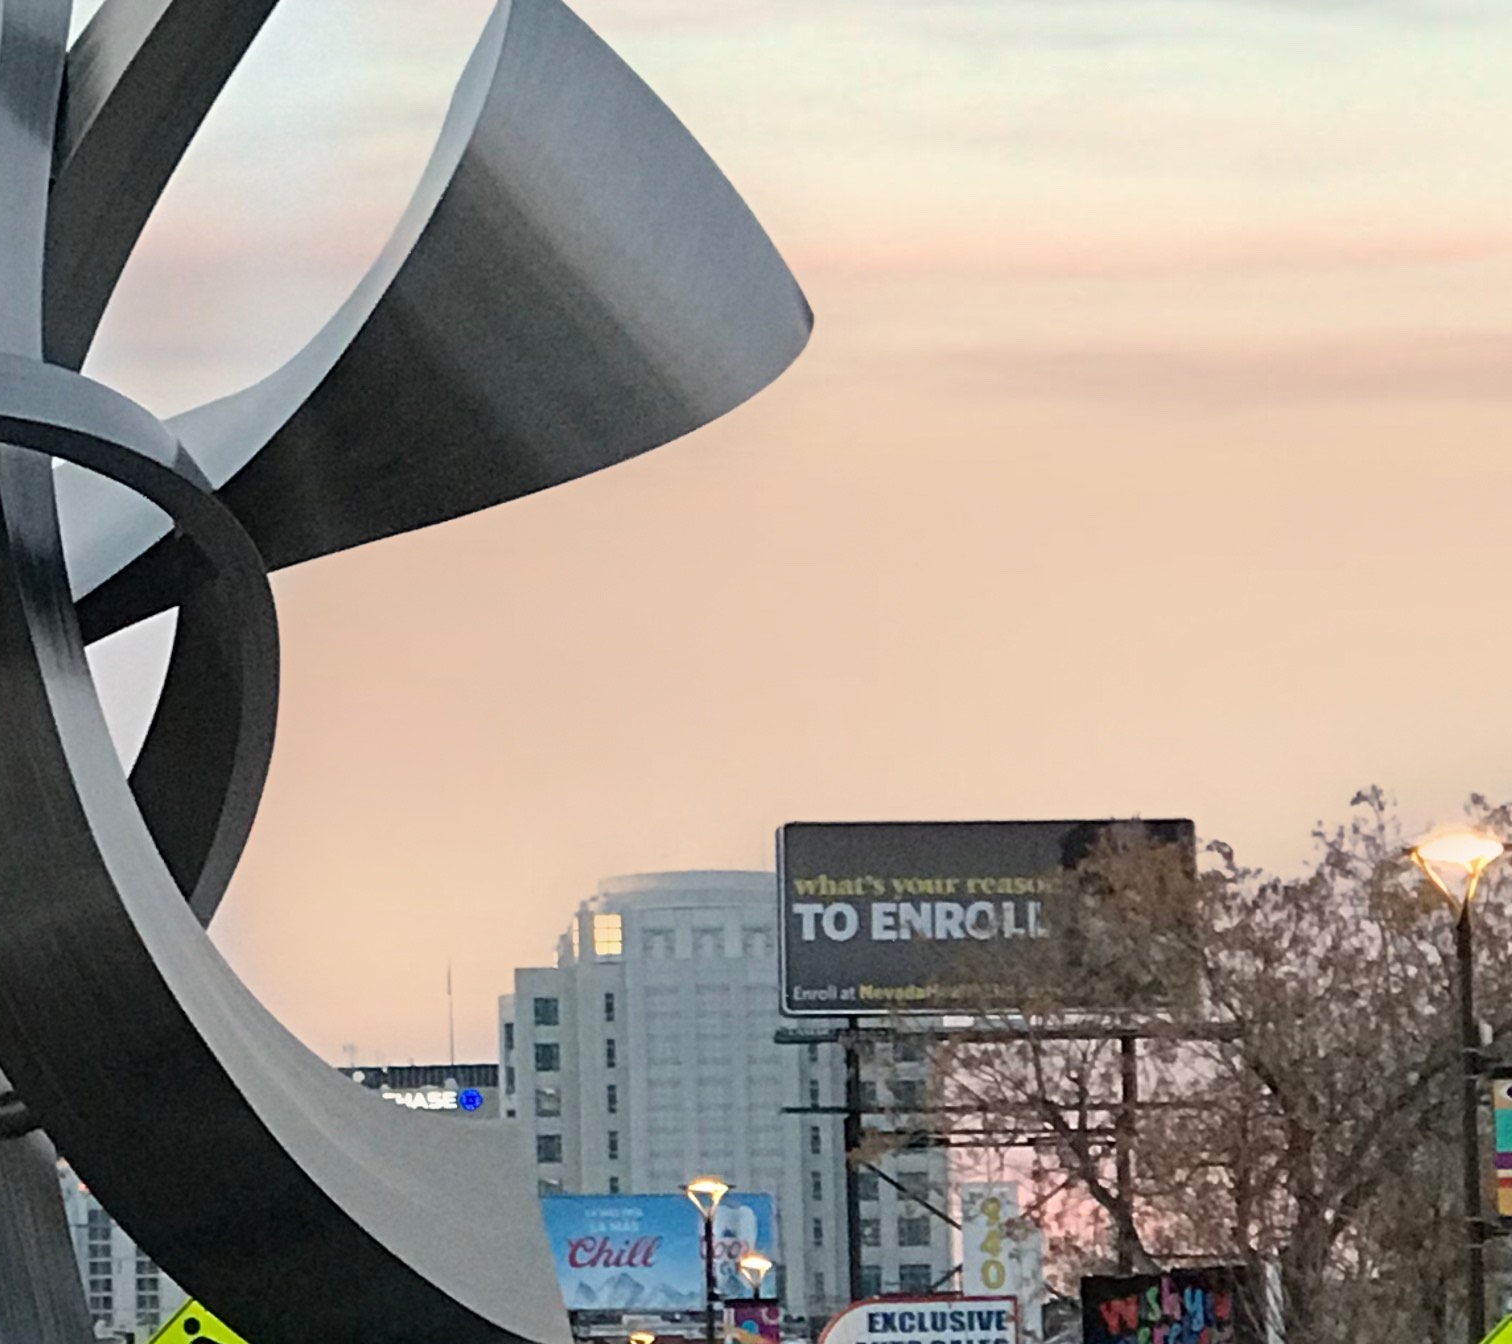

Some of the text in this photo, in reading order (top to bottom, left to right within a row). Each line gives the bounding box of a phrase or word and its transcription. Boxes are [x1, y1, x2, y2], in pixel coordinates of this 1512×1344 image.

[794, 874, 1058, 900] what's your reaso
[792, 901, 1049, 941] TO ENROLL
[793, 985, 837, 1001] Enroll
[840, 986, 857, 1001] at
[567, 1236, 663, 1268] Chill
[981, 1197, 1005, 1290] 940
[867, 1310, 1008, 1334] EXCLUSIVE
